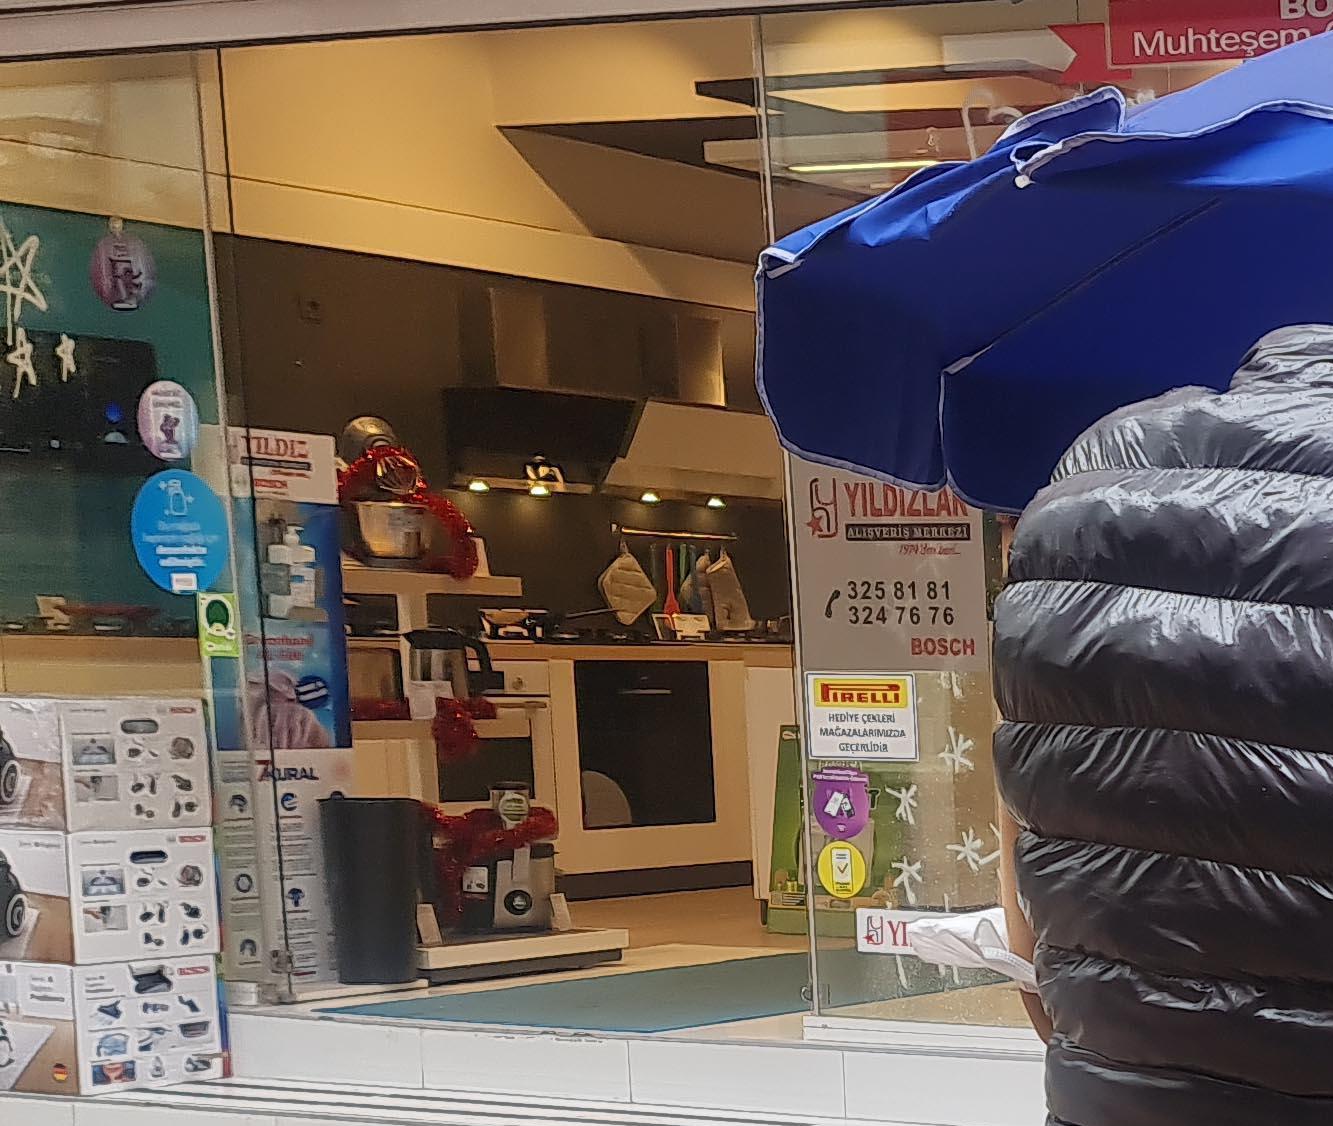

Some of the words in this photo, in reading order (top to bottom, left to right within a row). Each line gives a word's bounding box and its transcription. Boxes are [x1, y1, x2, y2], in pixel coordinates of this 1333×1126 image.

[1133, 24, 1310, 58] Muhteşem
[848, 527, 909, 540] ALIŞVERİŞ
[914, 527, 968, 539] MERKEZİ
[847, 581, 885, 600] 325
[893, 581, 917, 600] 81
[927, 581, 950, 600] 81
[849, 607, 887, 625] 324
[895, 607, 921, 625] 76
[930, 607, 954, 625] 76
[911, 638, 976, 656] BOSCH
[820, 682, 900, 704] PIRELLI
[828, 712, 860, 723] HEDİYE
[862, 711, 895, 725] ÇEKLERİ
[820, 726, 906, 738] MAĞAZALARIMIZDA
